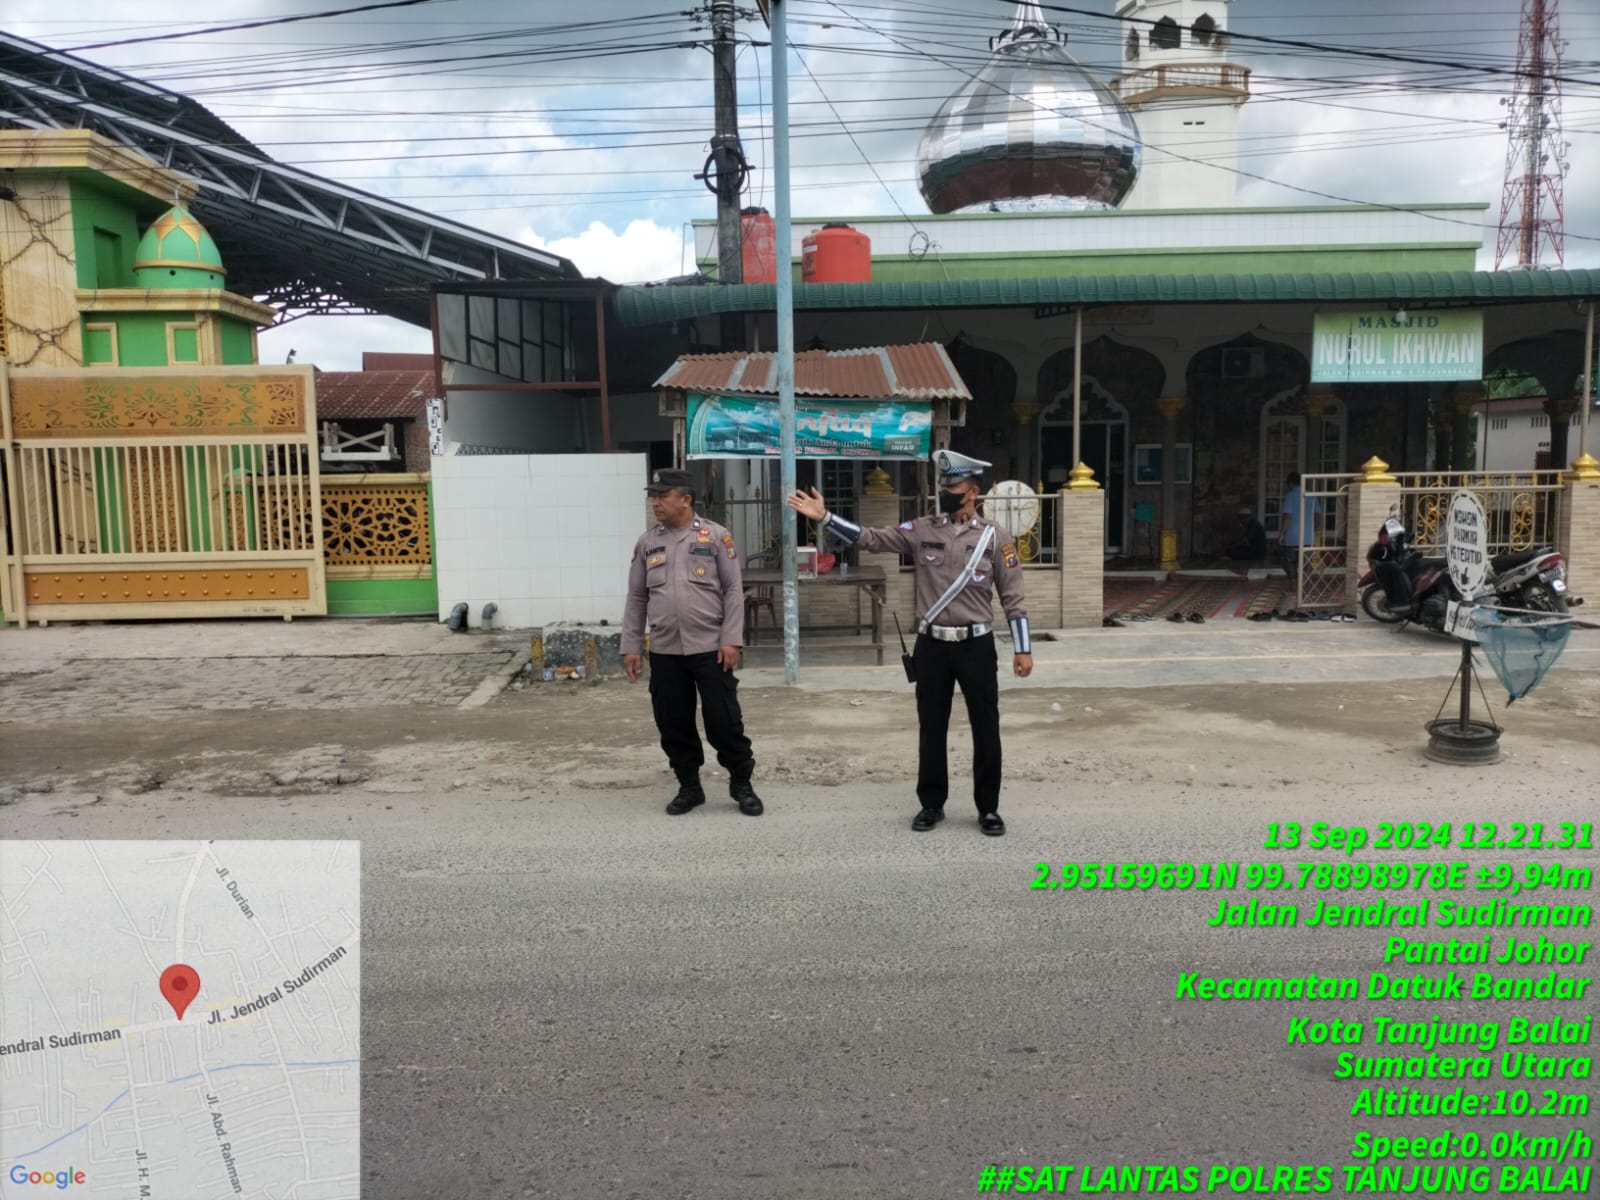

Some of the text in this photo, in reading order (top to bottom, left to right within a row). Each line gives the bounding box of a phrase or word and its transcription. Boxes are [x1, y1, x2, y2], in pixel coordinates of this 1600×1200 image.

[1358, 316, 1439, 328] MASJID
[1319, 332, 1475, 365] NURUL IKHWAN
[777, 412, 872, 439] nfaq
[1453, 526, 1478, 545] PARKIR
